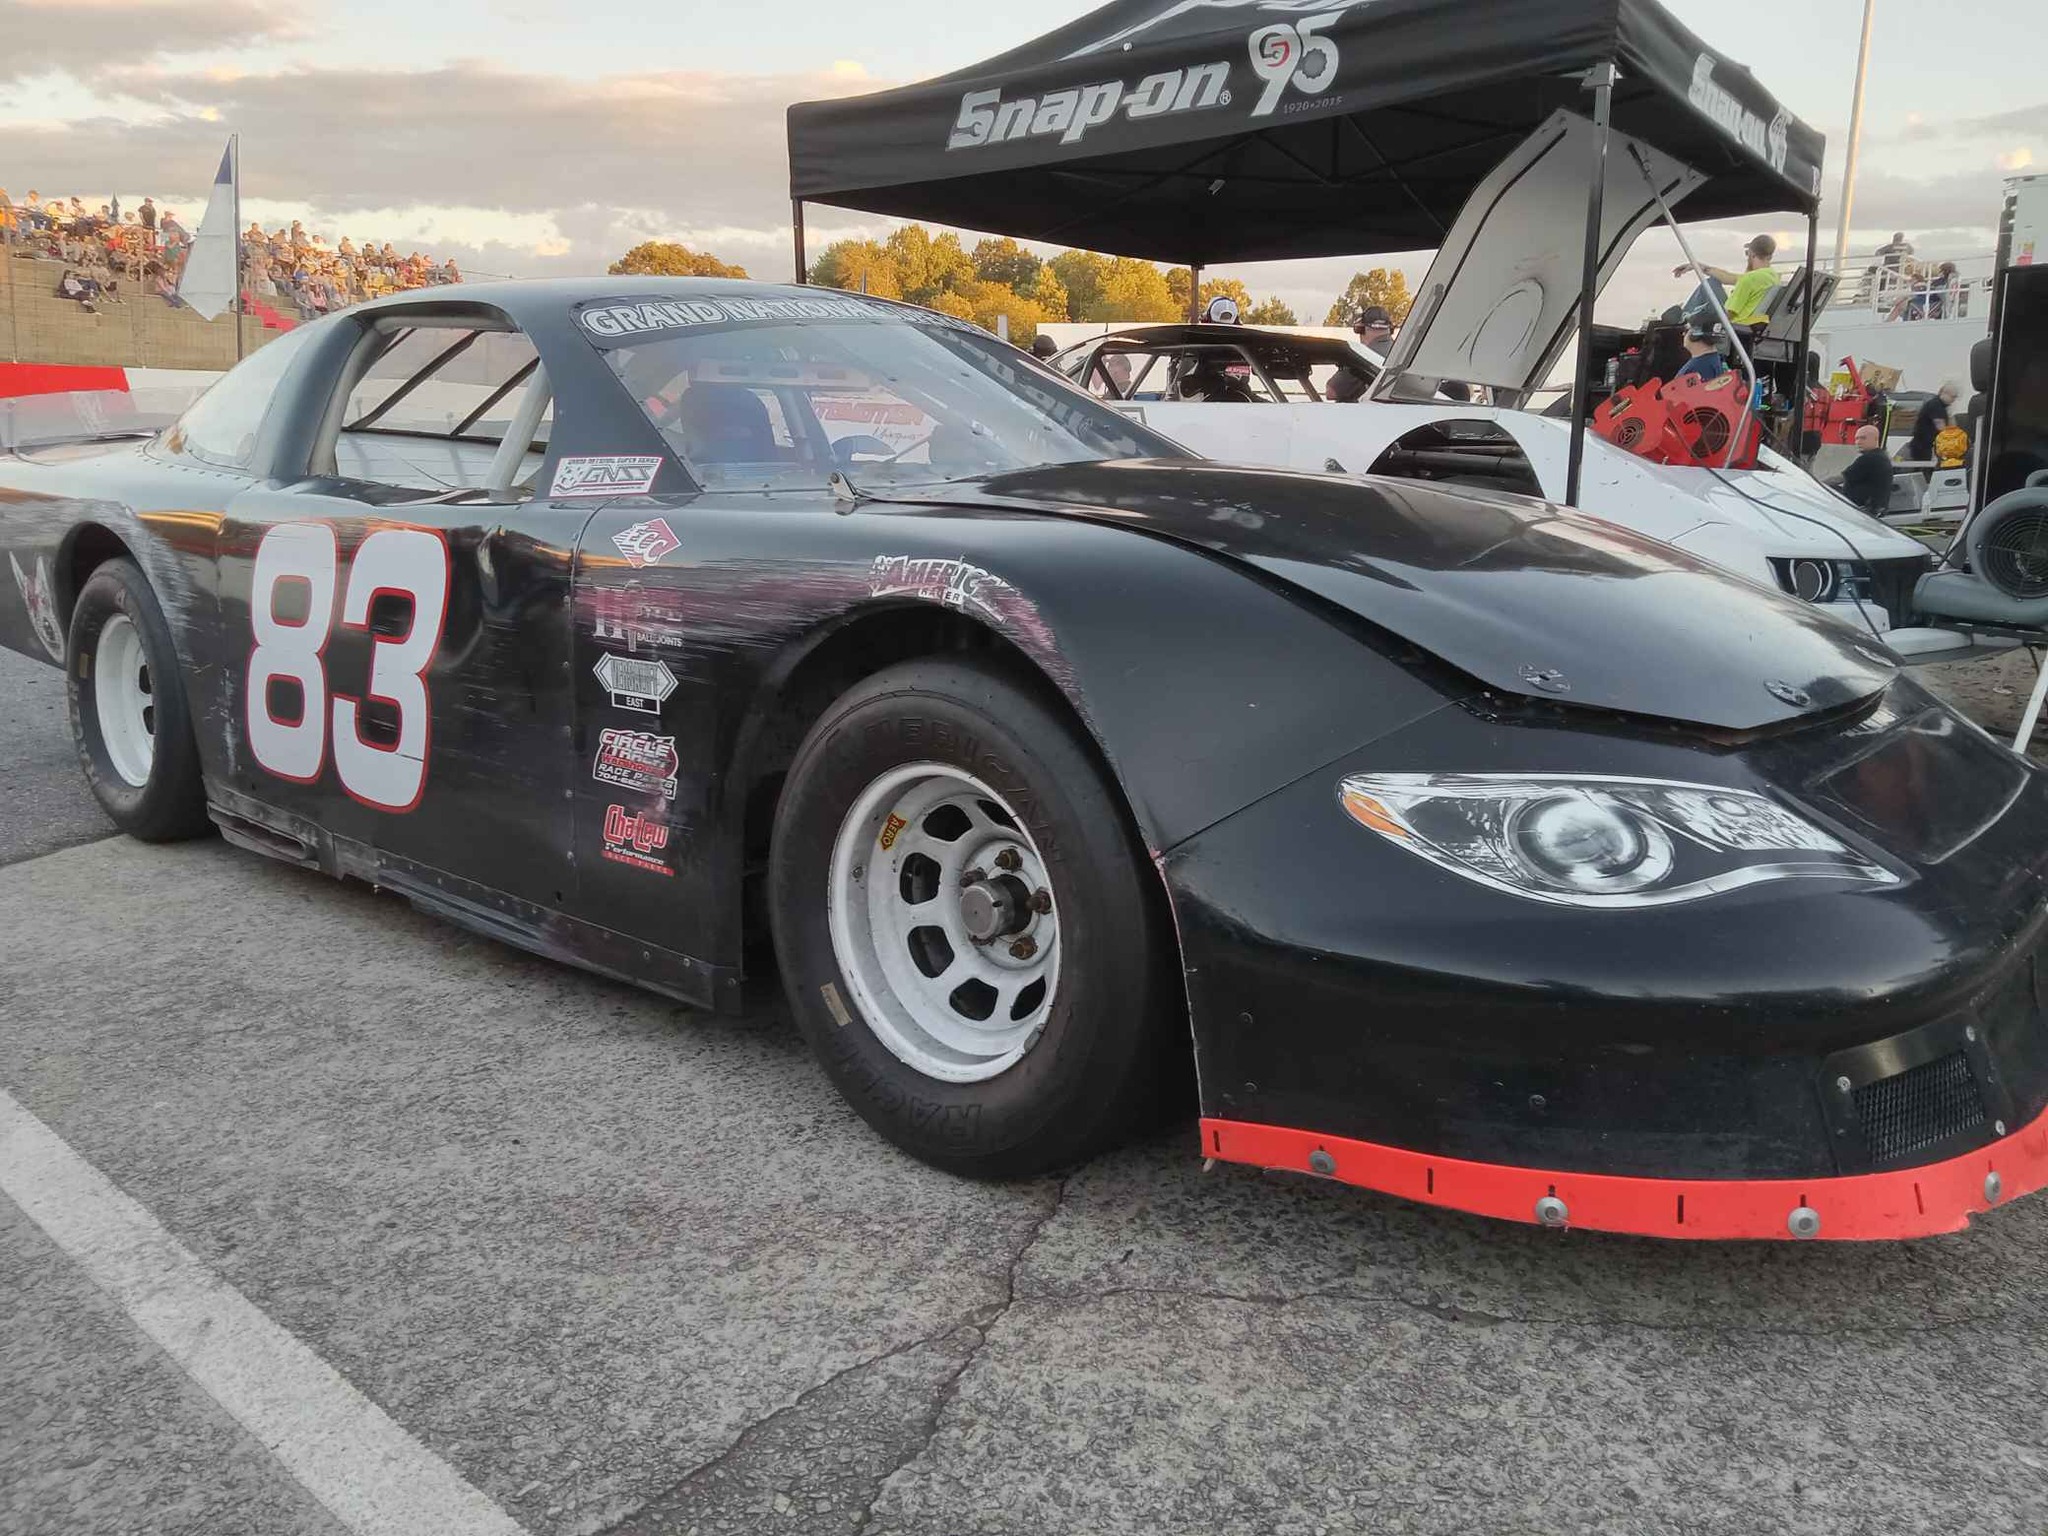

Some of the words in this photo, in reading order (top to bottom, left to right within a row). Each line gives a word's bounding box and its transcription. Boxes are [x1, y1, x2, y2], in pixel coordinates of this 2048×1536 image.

[1249, 9, 1347, 118] 95
[581, 300, 729, 337] GRAND
[245, 519, 452, 814] 83
[625, 696, 644, 708] EAST
[601, 731, 671, 760] CIRCLE
[597, 763, 631, 777] RACE
[881, 815, 899, 846] AERO
